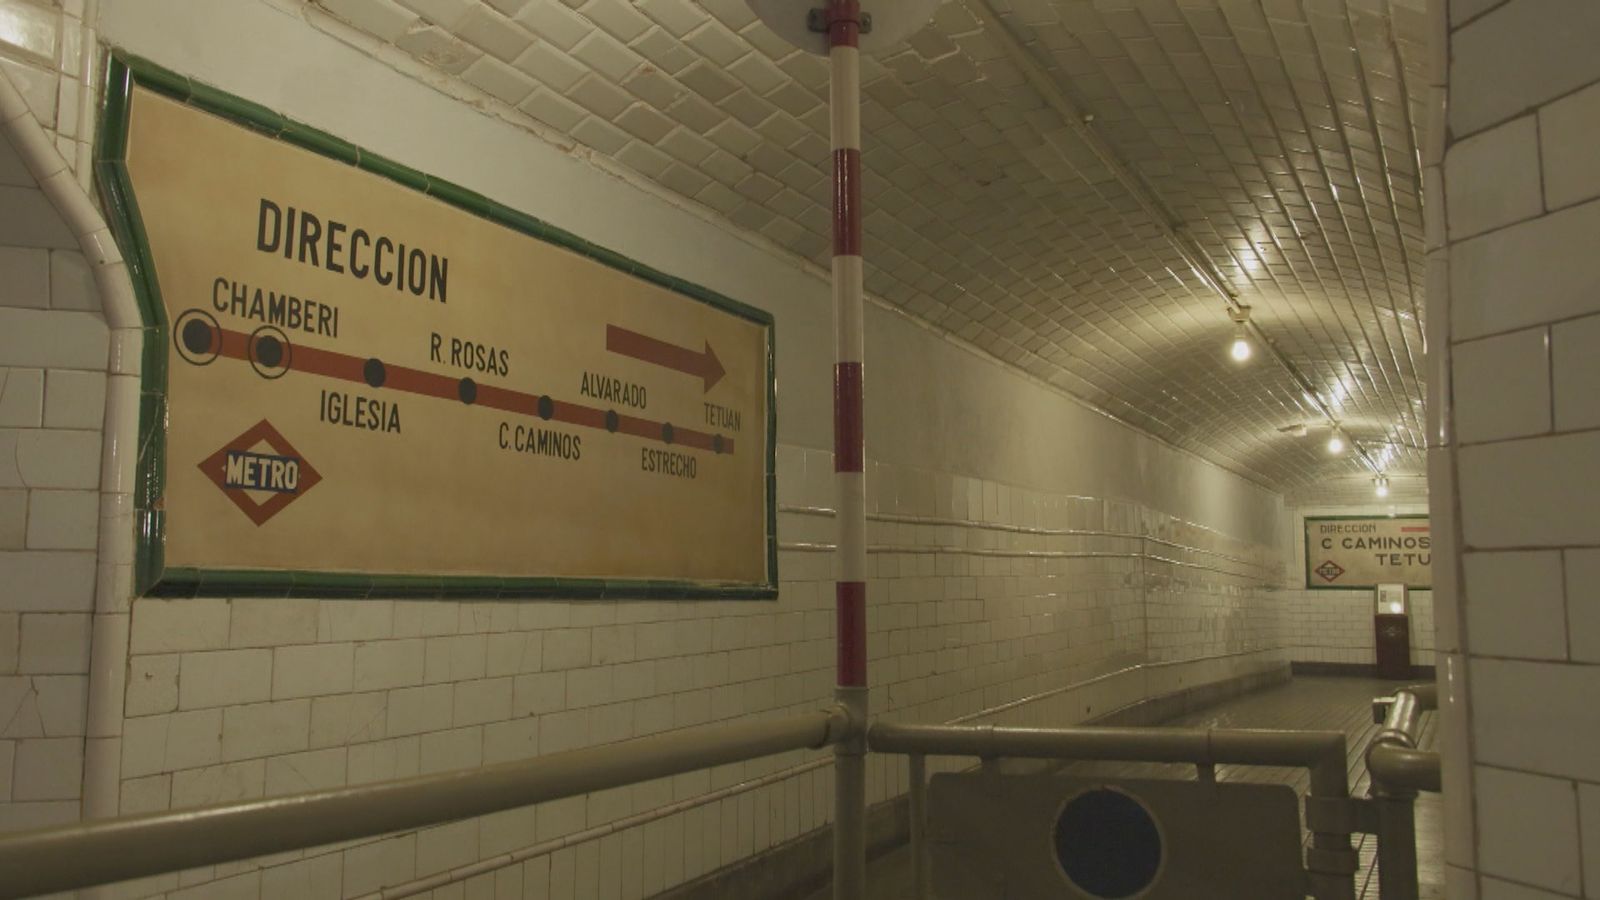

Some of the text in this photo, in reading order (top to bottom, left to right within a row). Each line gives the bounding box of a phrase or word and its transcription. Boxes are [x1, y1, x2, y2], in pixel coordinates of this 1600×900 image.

[257, 198, 448, 304] DIRECCION
[212, 277, 339, 338] CHAMBERI
[581, 371, 647, 410] ALVARADO
[320, 390, 401, 434] IGLESIA
[704, 403, 741, 433] TETUAN
[226, 453, 299, 491] METRO
[641, 448, 697, 480] ESTRECHO
[1320, 525, 1376, 534] DIRECCION
[1342, 537, 1431, 550] CAMINOS
